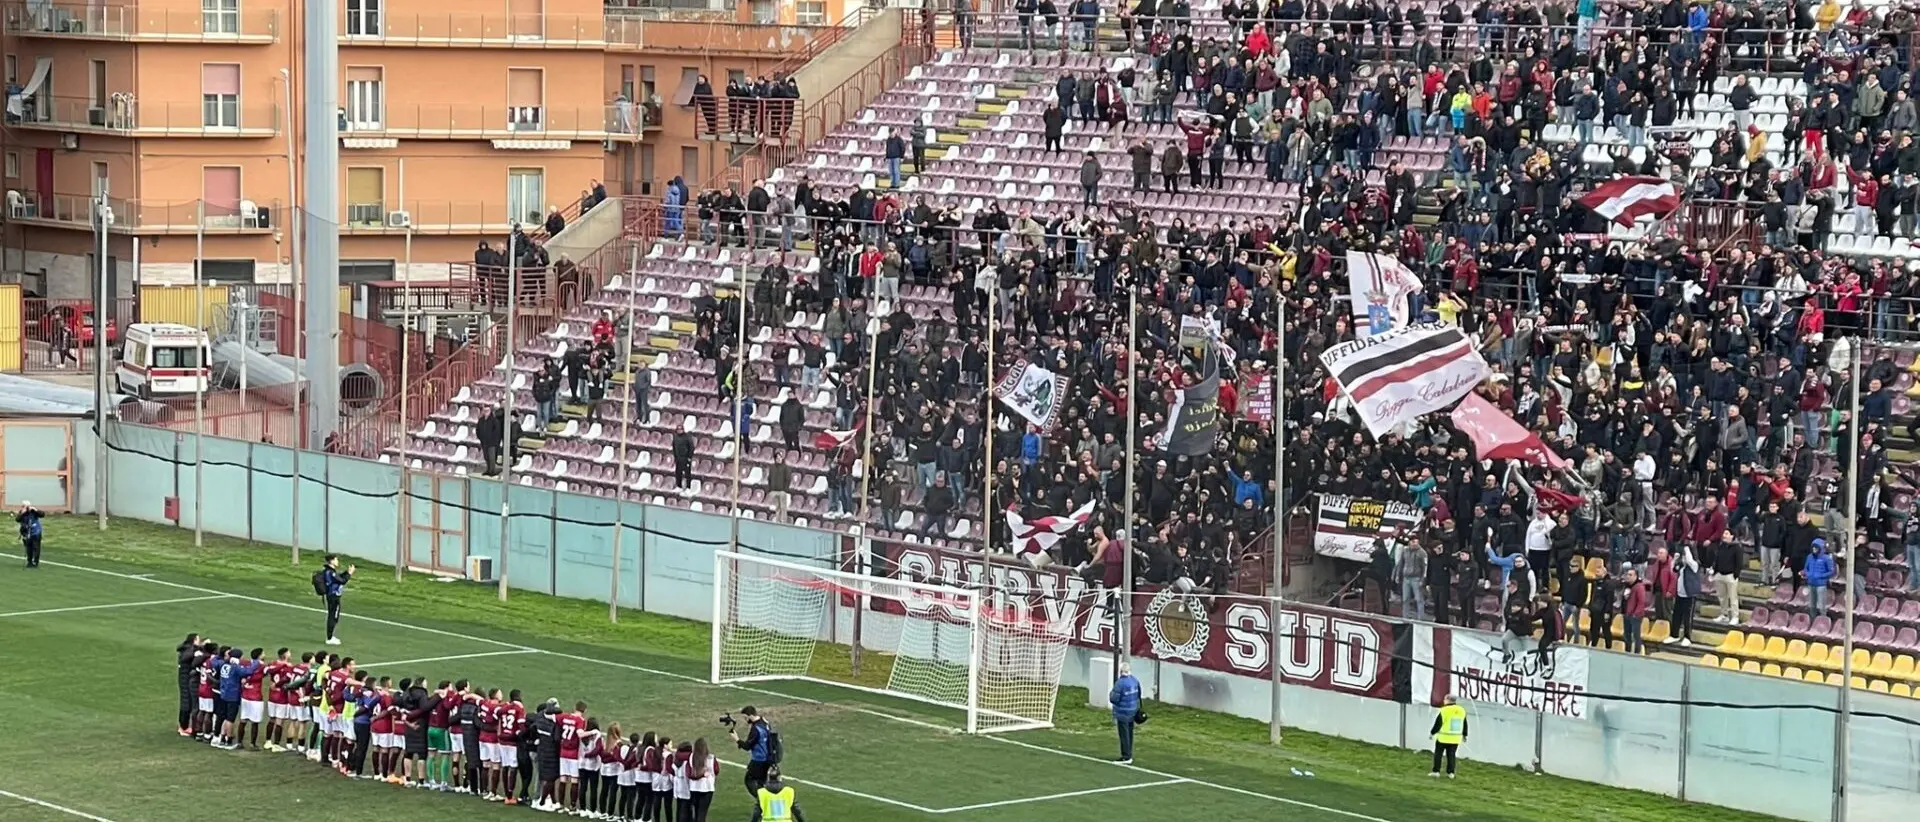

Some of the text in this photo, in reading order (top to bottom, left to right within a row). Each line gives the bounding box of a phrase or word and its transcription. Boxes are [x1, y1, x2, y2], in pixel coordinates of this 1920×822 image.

[898, 549, 1380, 692] CURVA SUD
[501, 714, 516, 730] 12
